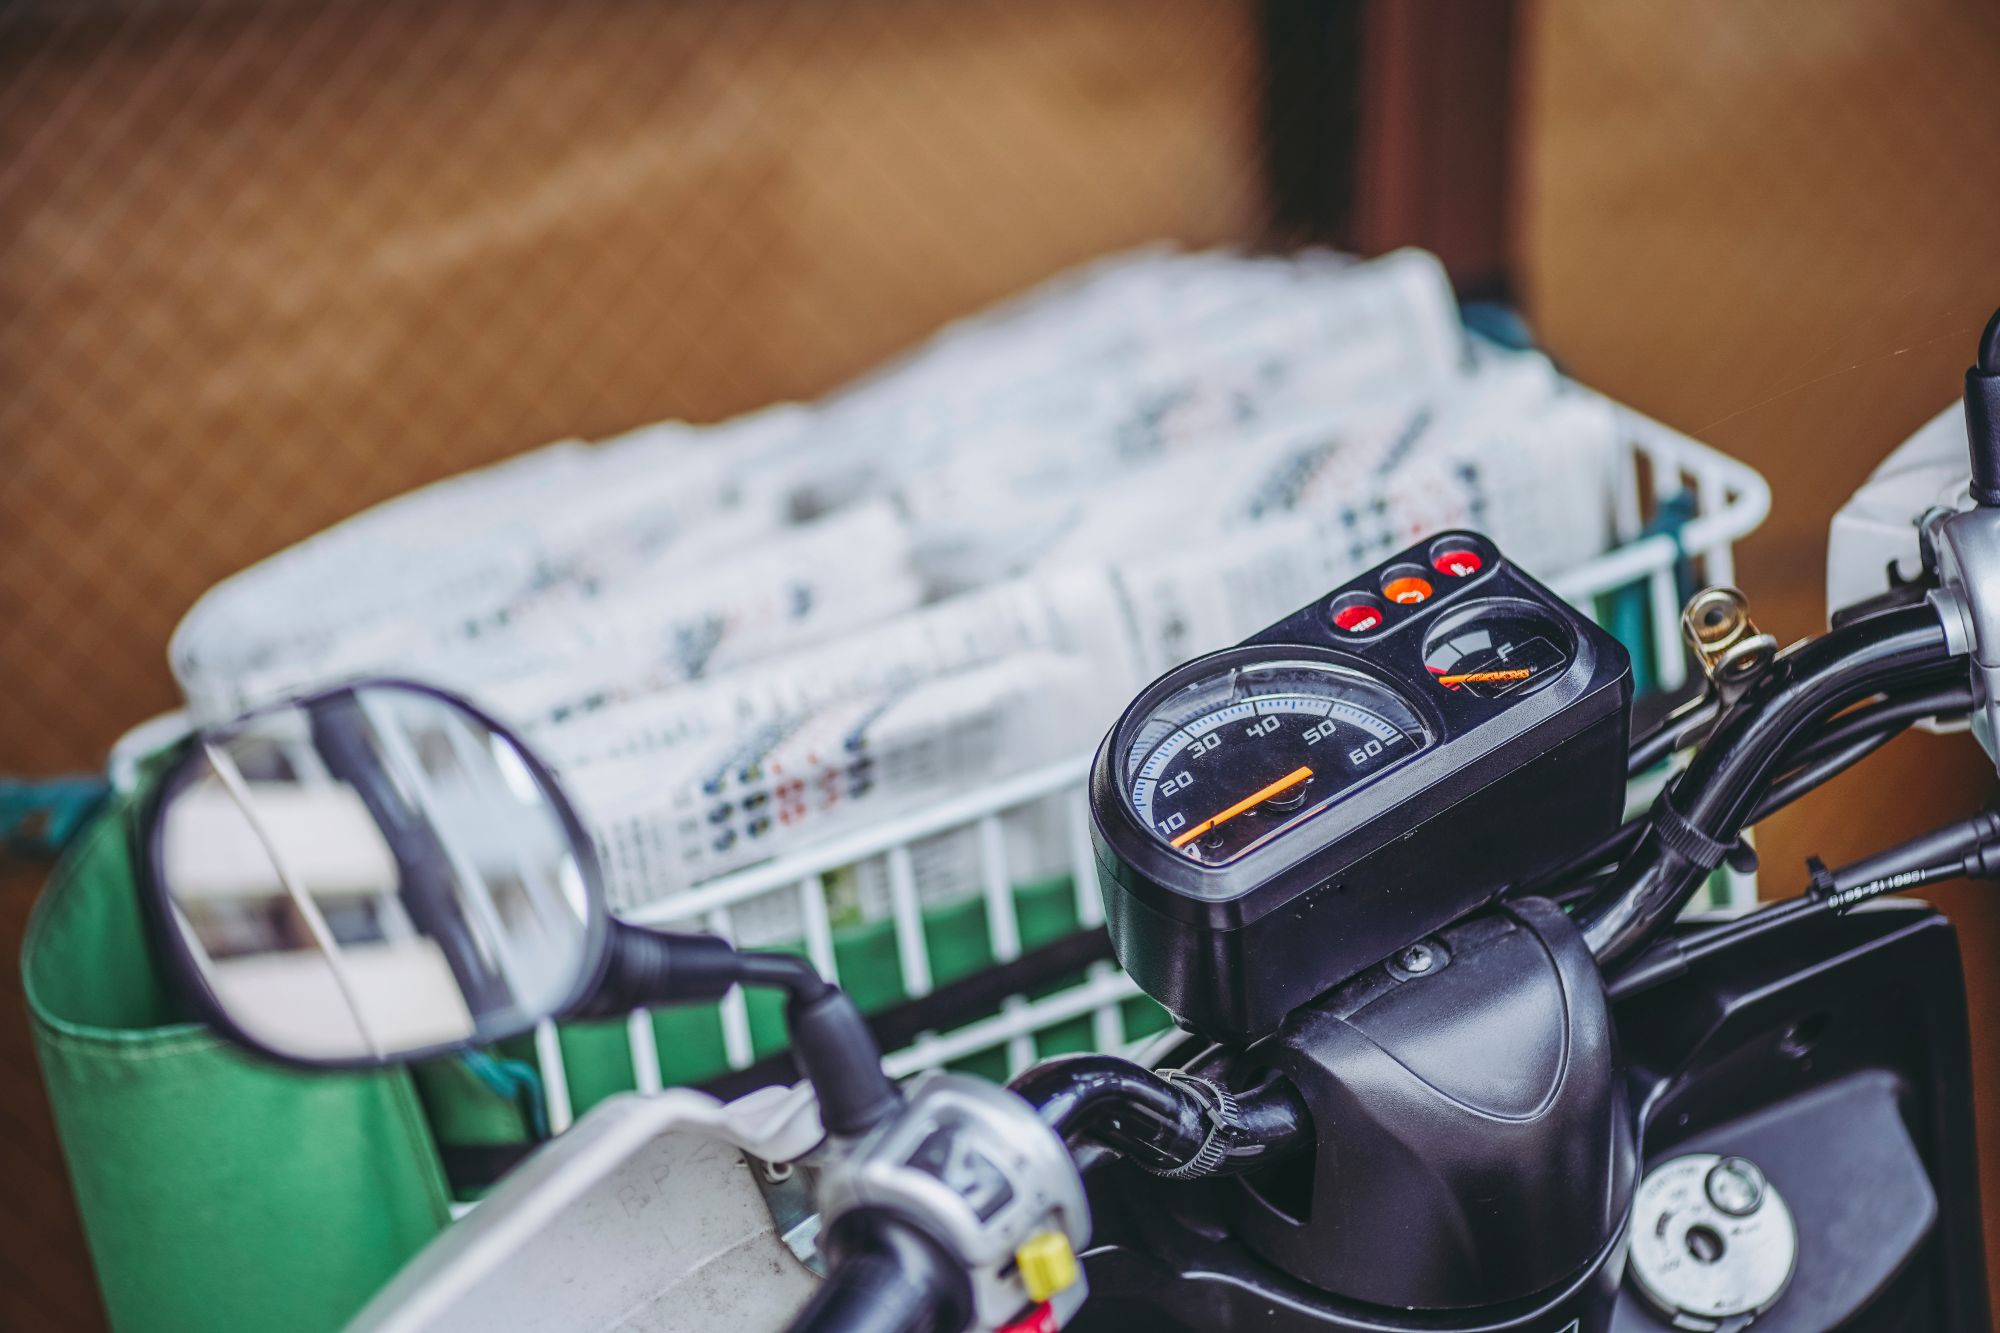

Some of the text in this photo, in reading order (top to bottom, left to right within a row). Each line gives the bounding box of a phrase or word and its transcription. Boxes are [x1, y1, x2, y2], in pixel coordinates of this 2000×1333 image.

[1246, 715, 1281, 739] 40
[1302, 719, 1337, 746] 50
[1187, 732, 1222, 760] 30
[1349, 741, 1383, 767] 60
[1159, 770, 1195, 798] 20
[1158, 811, 1187, 835] 10
